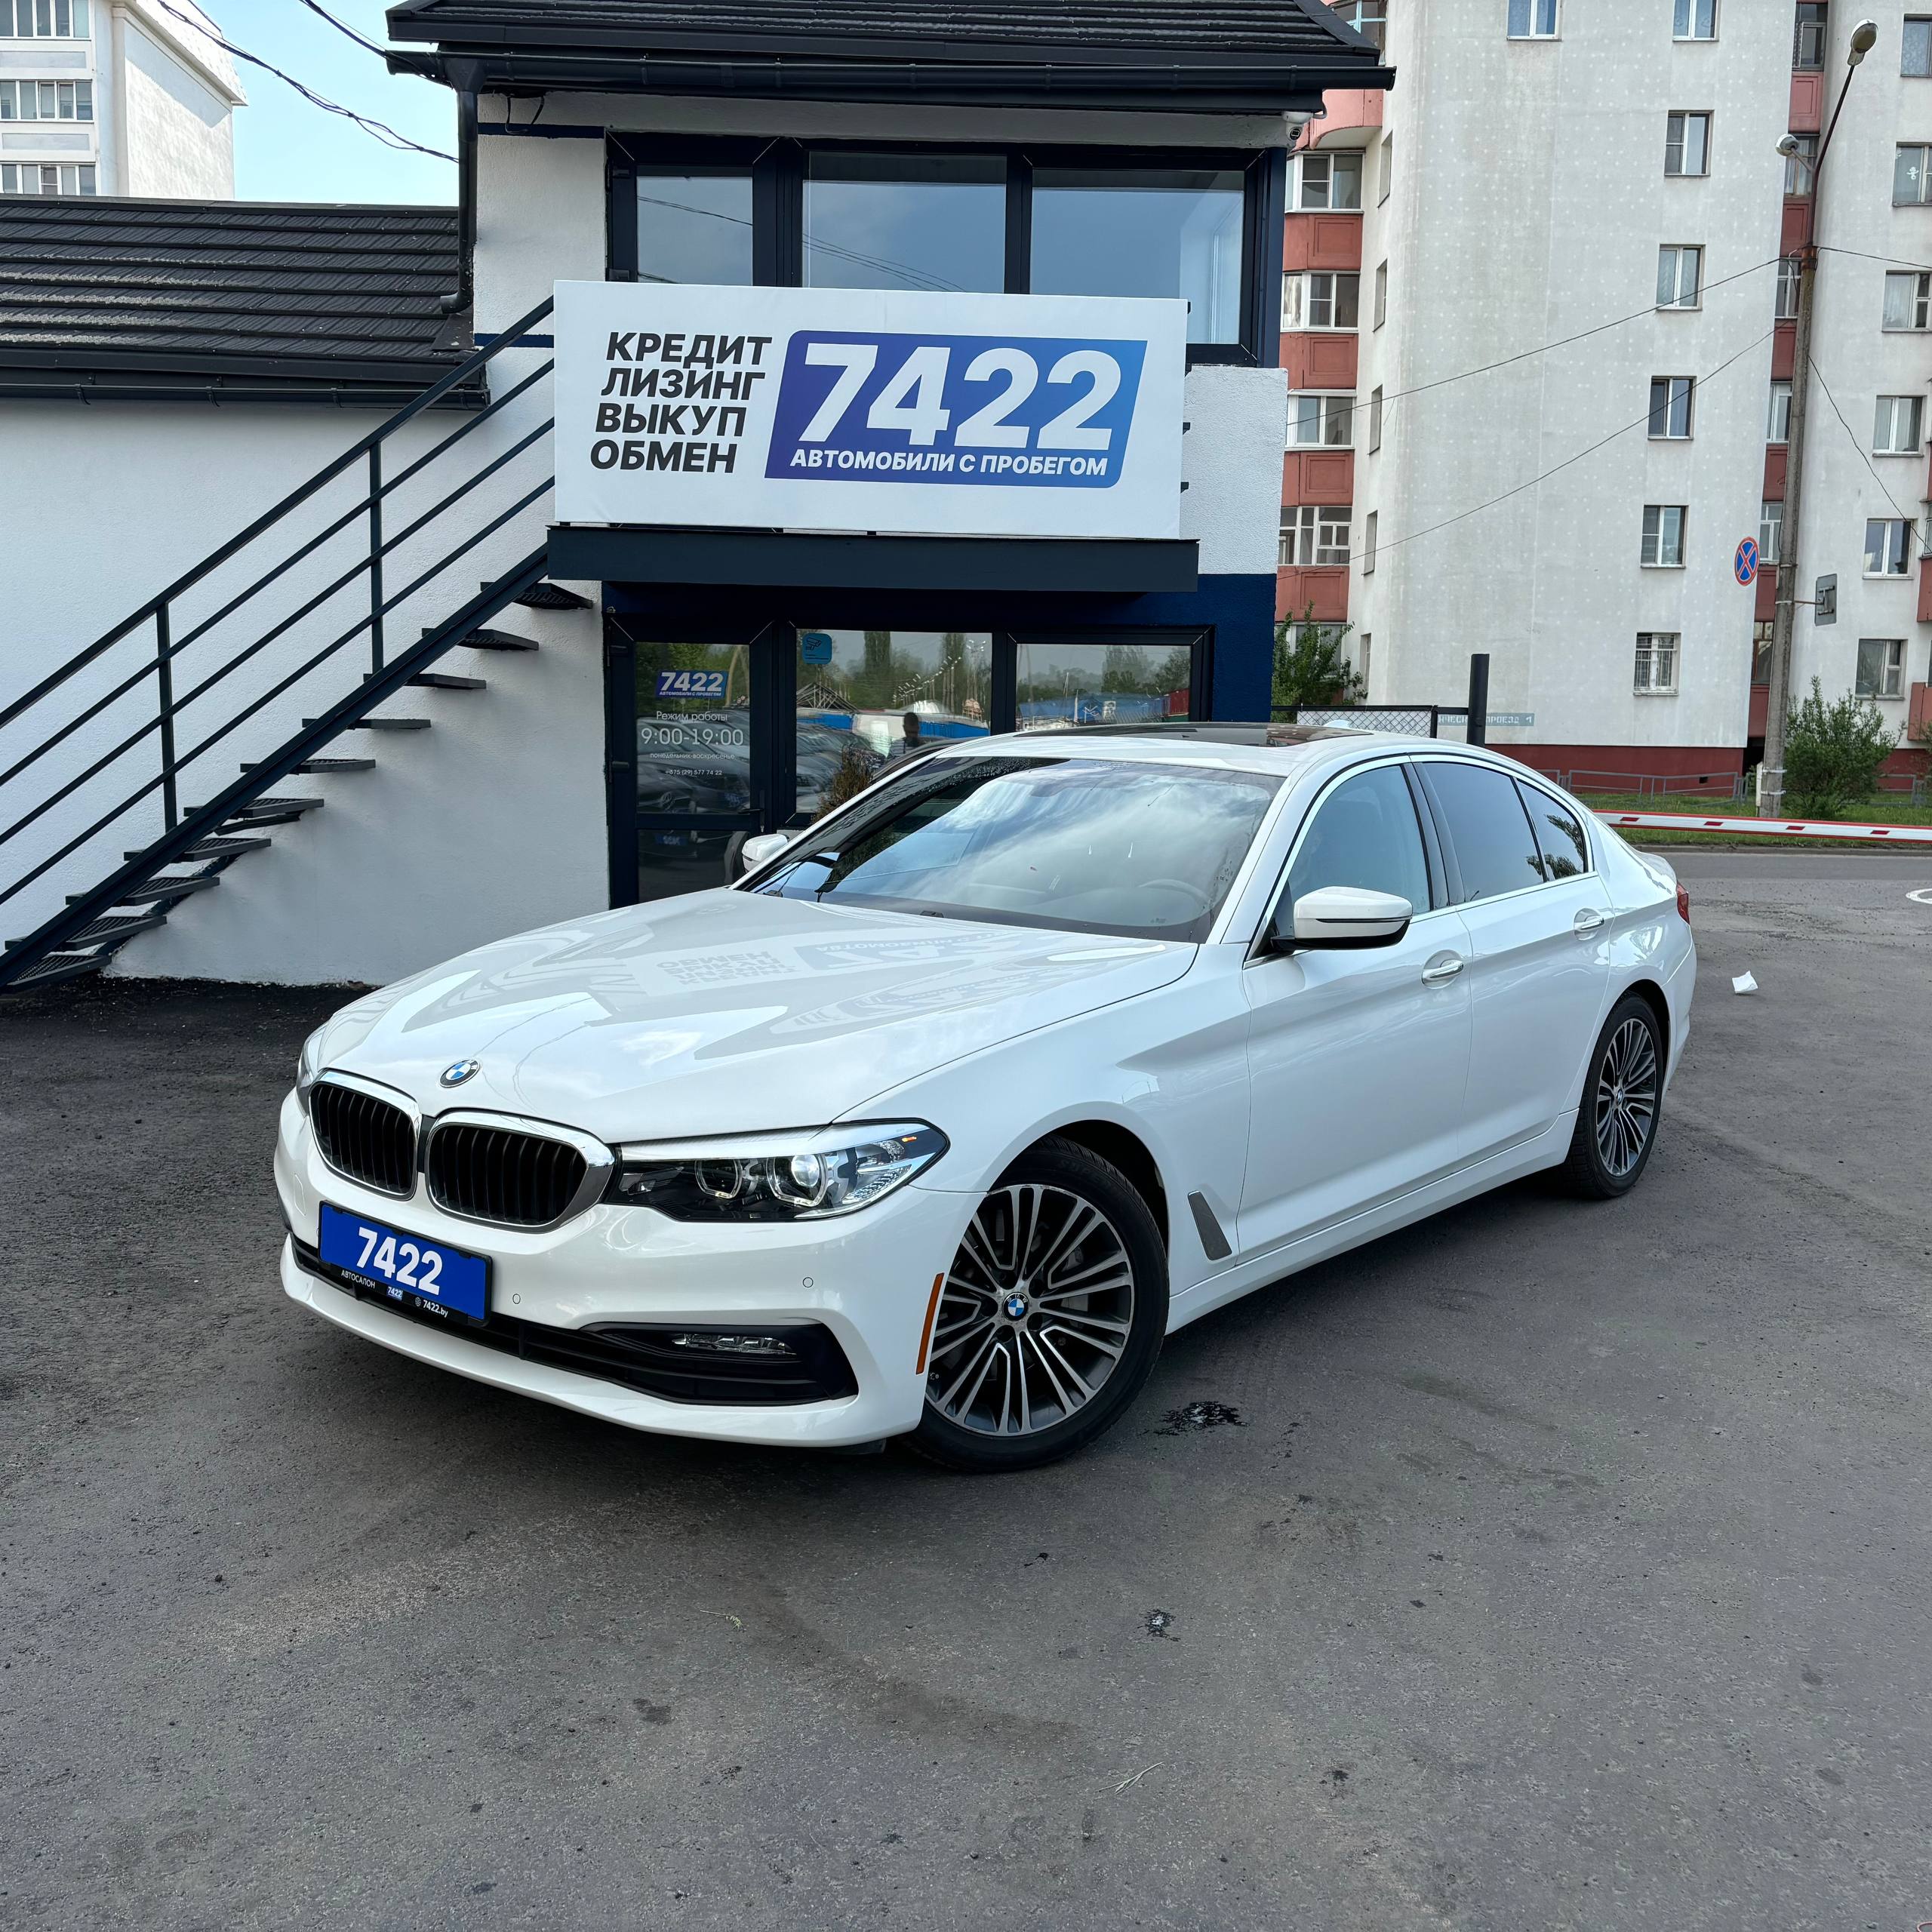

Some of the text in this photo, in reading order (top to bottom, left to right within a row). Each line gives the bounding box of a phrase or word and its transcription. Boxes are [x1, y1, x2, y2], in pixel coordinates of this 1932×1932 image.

[606, 332, 772, 369] КРЕДИТ
[601, 368, 766, 401] ЛИЗИНГ
[798, 343, 1122, 451] 7422
[596, 401, 747, 436] ВЫКУП
[590, 439, 737, 474] ОБМЕН
[790, 448, 1107, 475] АВТОМОБИЛИ С ПРОБЕГОМ
[661, 672, 724, 691] 7422
[657, 711, 728, 721] Режим работы
[641, 728, 744, 746] 9:00-19:00
[356, 1226, 443, 1296] 7422
[341, 1269, 376, 1289] АВТОСАЛОН
[387, 1286, 403, 1298] 7422
[423, 1300, 448, 1318] 7422.by
